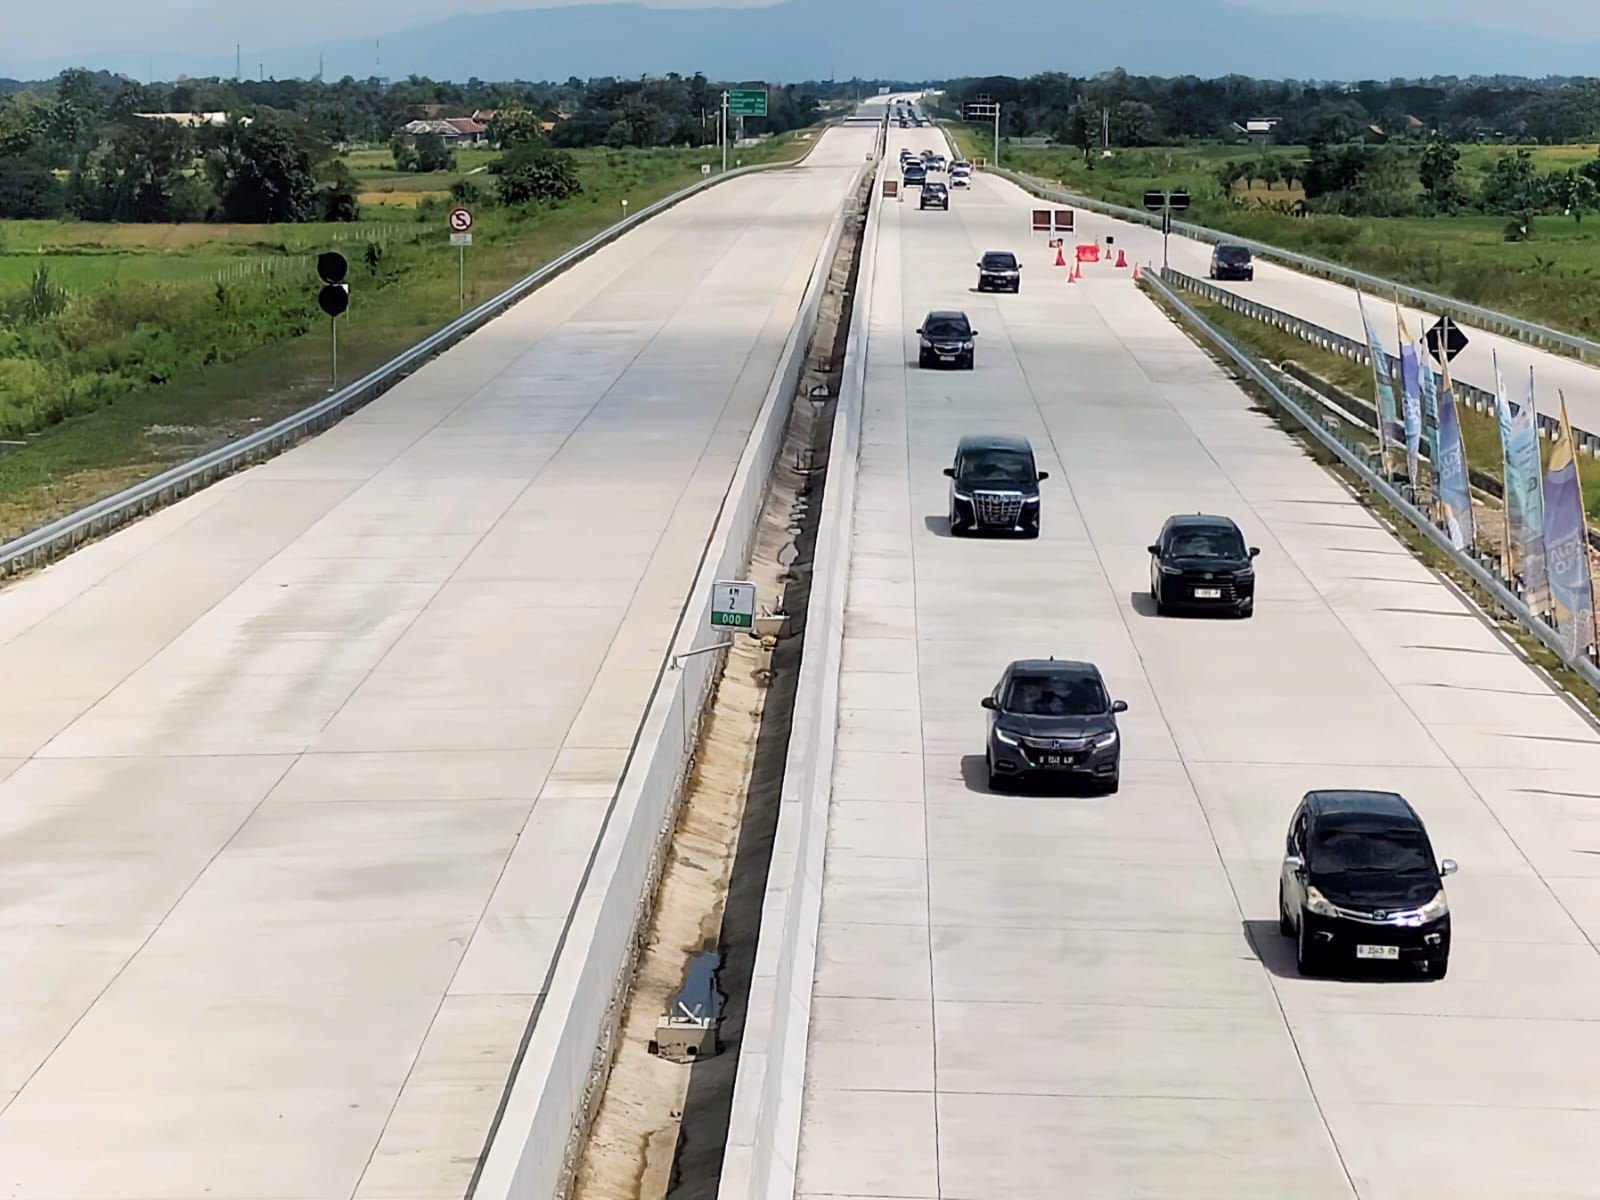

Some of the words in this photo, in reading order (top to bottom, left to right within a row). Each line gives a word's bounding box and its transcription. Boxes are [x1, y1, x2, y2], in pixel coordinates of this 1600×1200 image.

[456, 213, 466, 227] S
[729, 597, 735, 610] 2
[722, 613, 741, 625] 000
